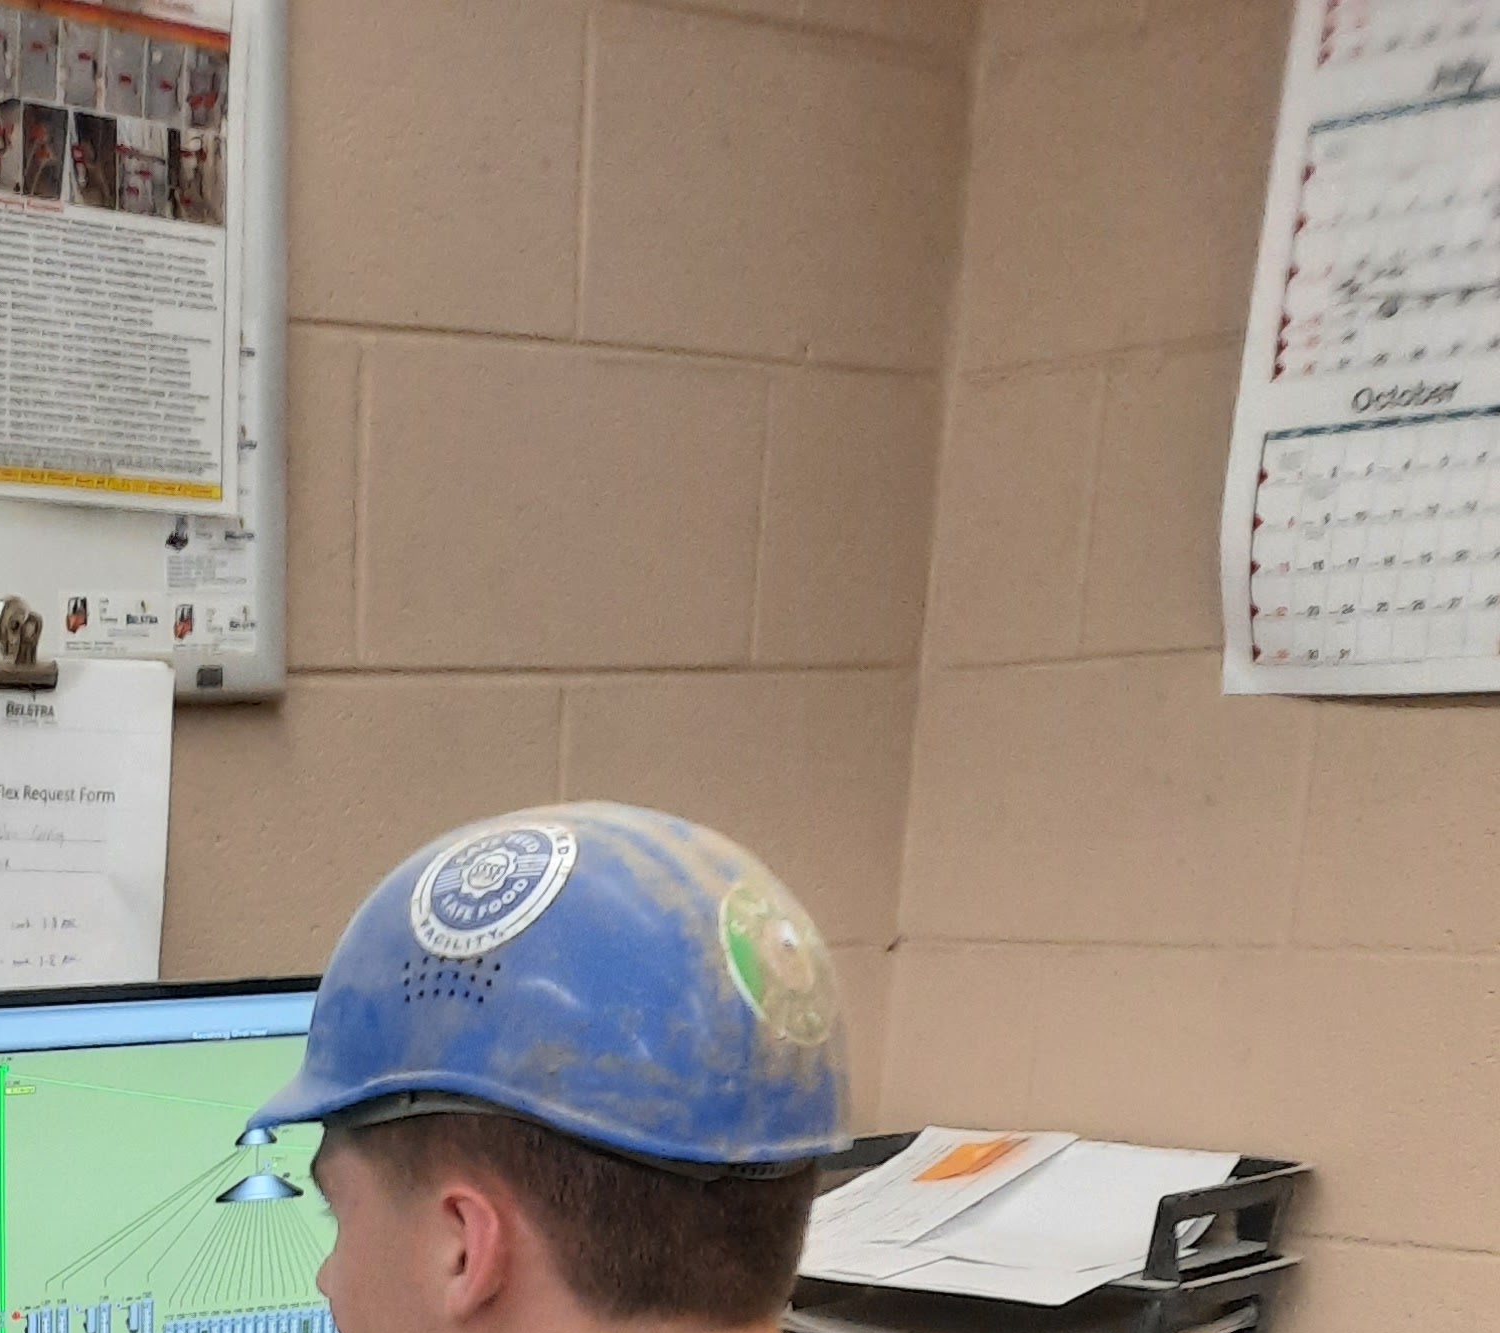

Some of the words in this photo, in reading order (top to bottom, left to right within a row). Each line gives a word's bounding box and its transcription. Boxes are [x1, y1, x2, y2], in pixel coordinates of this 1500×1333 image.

[1352, 380, 1462, 413] October
[23, 786, 75, 807] Request
[80, 787, 116, 803] Form
[477, 877, 529, 920] FOOD
